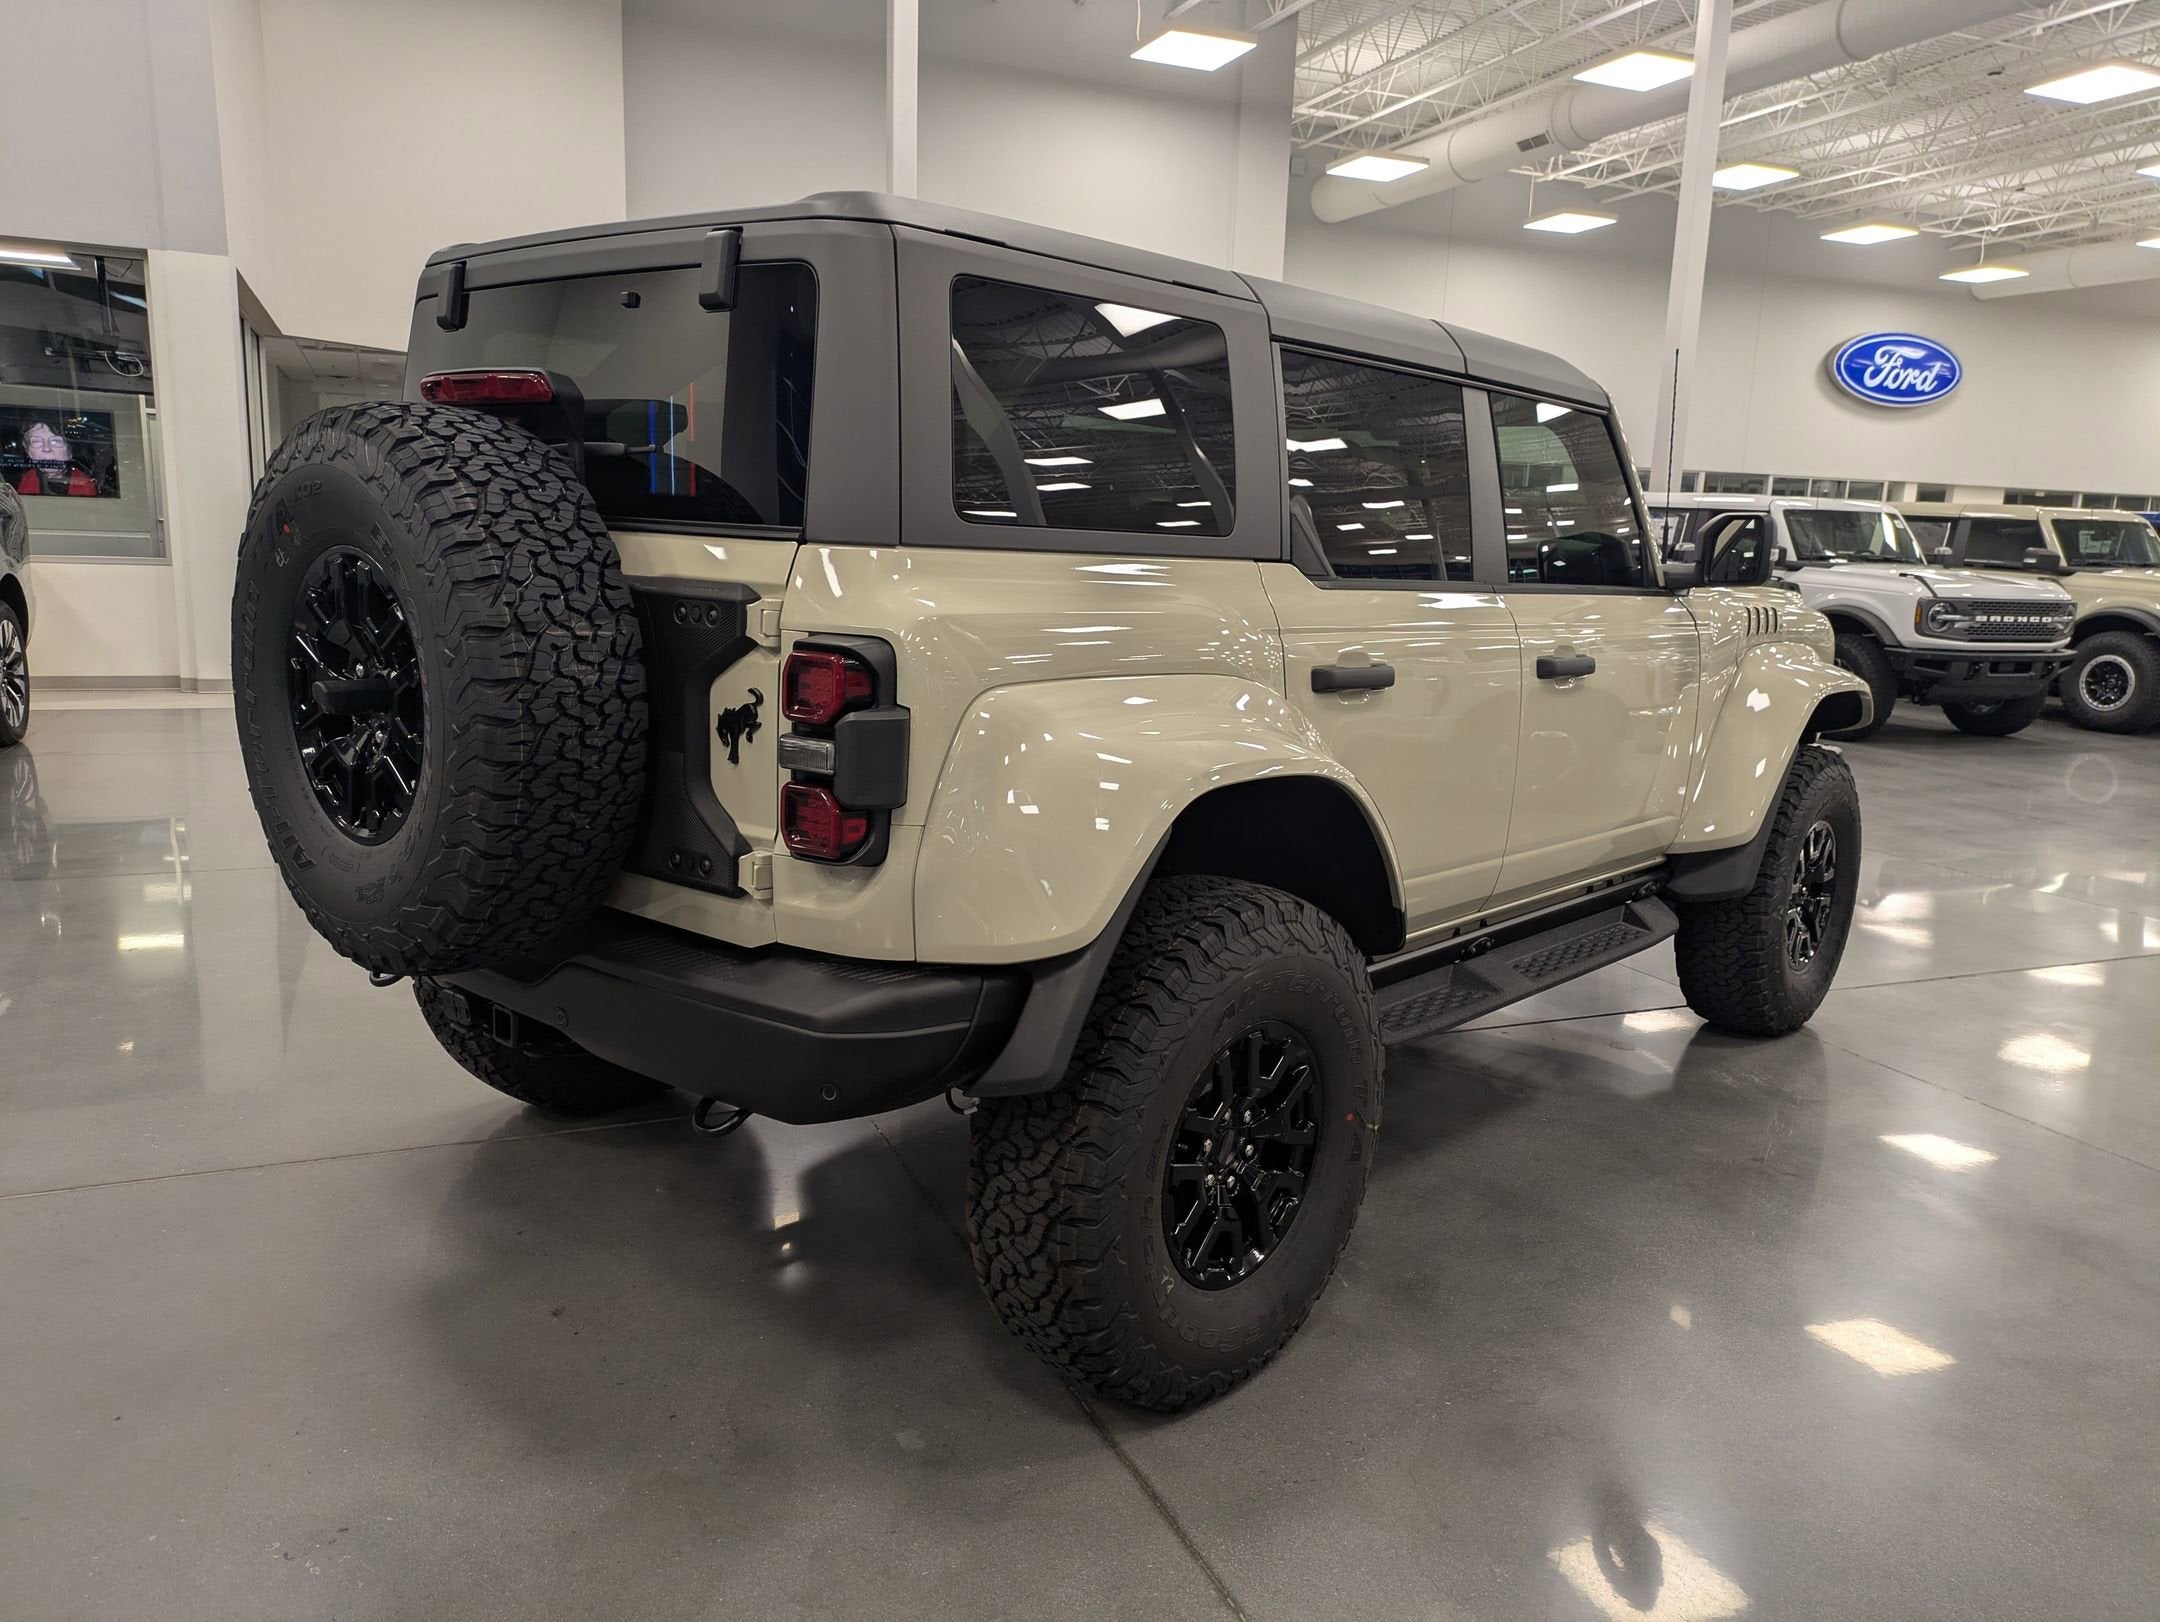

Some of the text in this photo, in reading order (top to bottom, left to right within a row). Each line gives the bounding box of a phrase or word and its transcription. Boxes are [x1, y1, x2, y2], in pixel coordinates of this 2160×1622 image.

[1863, 344, 1941, 393] Ford
[1975, 615, 2052, 623] BRONCO
[1212, 968, 1363, 1065] All-Terrain
